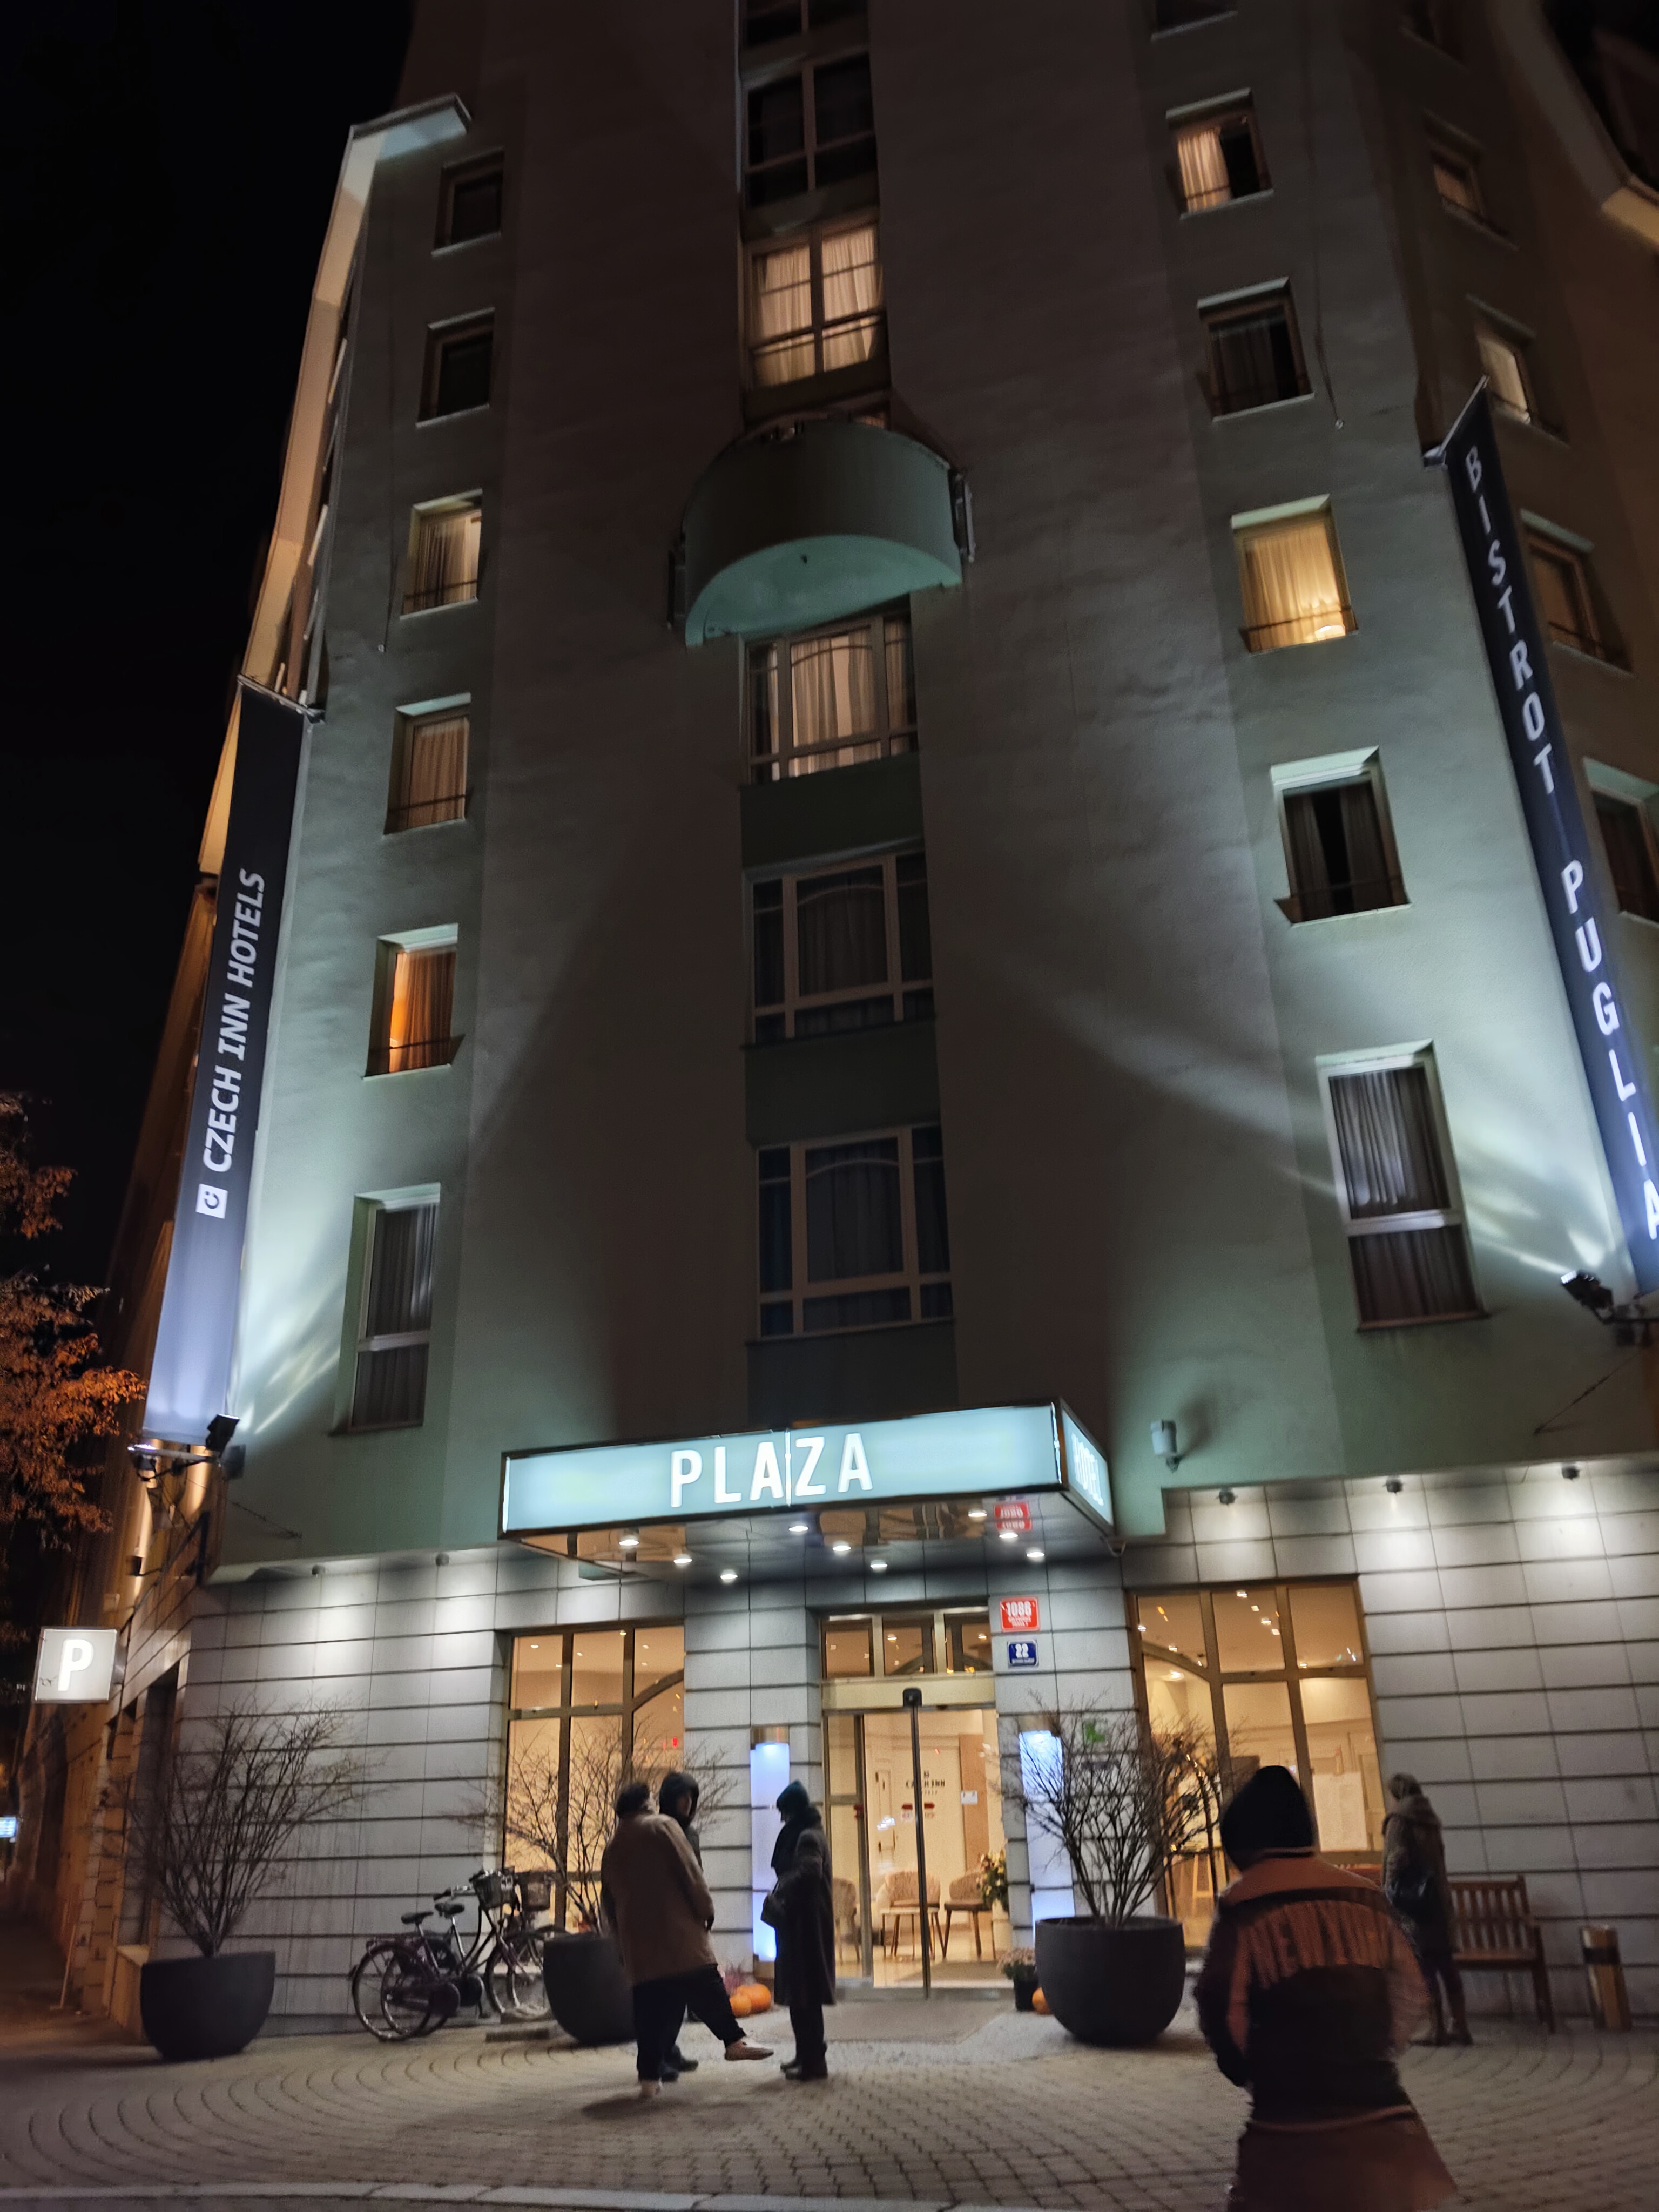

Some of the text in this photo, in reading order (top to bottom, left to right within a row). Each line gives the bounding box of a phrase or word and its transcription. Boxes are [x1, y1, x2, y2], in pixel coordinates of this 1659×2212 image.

[1465, 446, 1659, 1240] BISTROT PUGLIA
[227, 868, 266, 987] HOTELS
[218, 993, 251, 1061] INN
[203, 1065, 242, 1172] CZECH
[670, 1433, 873, 1508] PLAZA
[1071, 1432, 1104, 1506] HOTEL
[57, 1638, 95, 1691] P
